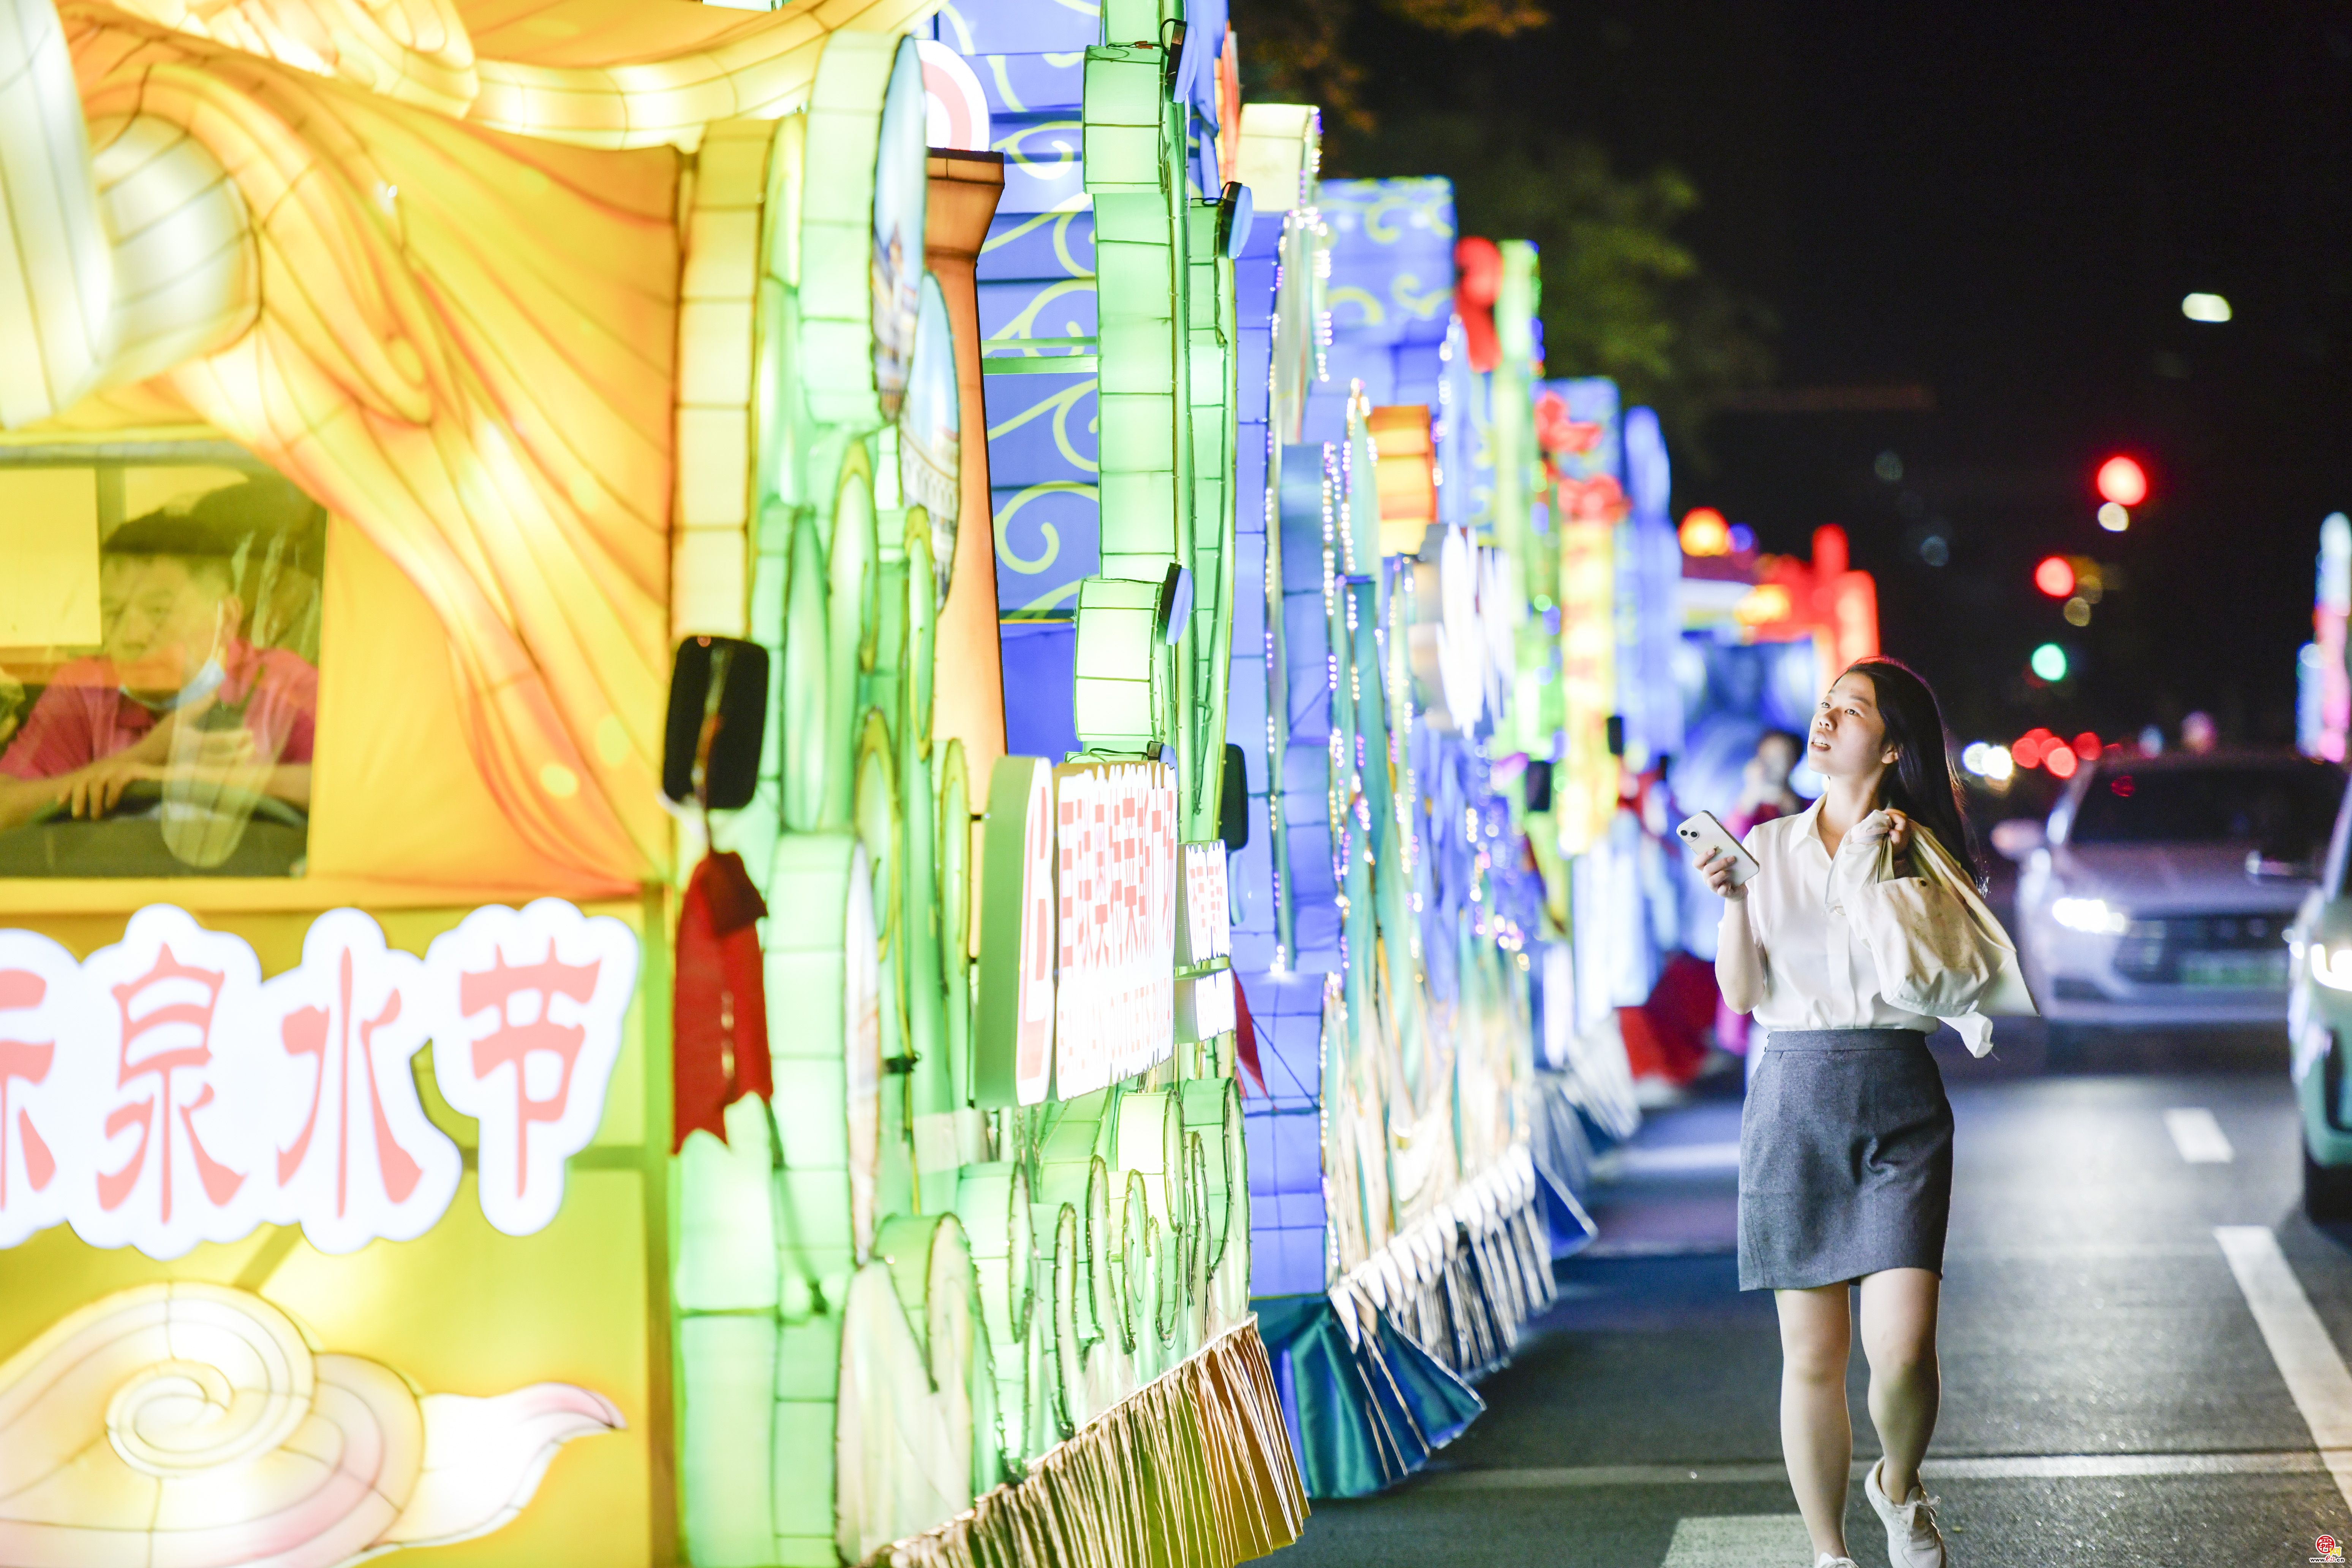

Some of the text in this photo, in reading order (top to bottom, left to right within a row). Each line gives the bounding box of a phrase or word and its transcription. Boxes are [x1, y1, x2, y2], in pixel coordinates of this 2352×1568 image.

[1060, 786, 1173, 980] 百联奥特莱斯广场
[1110, 984, 1151, 1060] OUTLETS
[1152, 976, 1170, 1044] PLAZA
